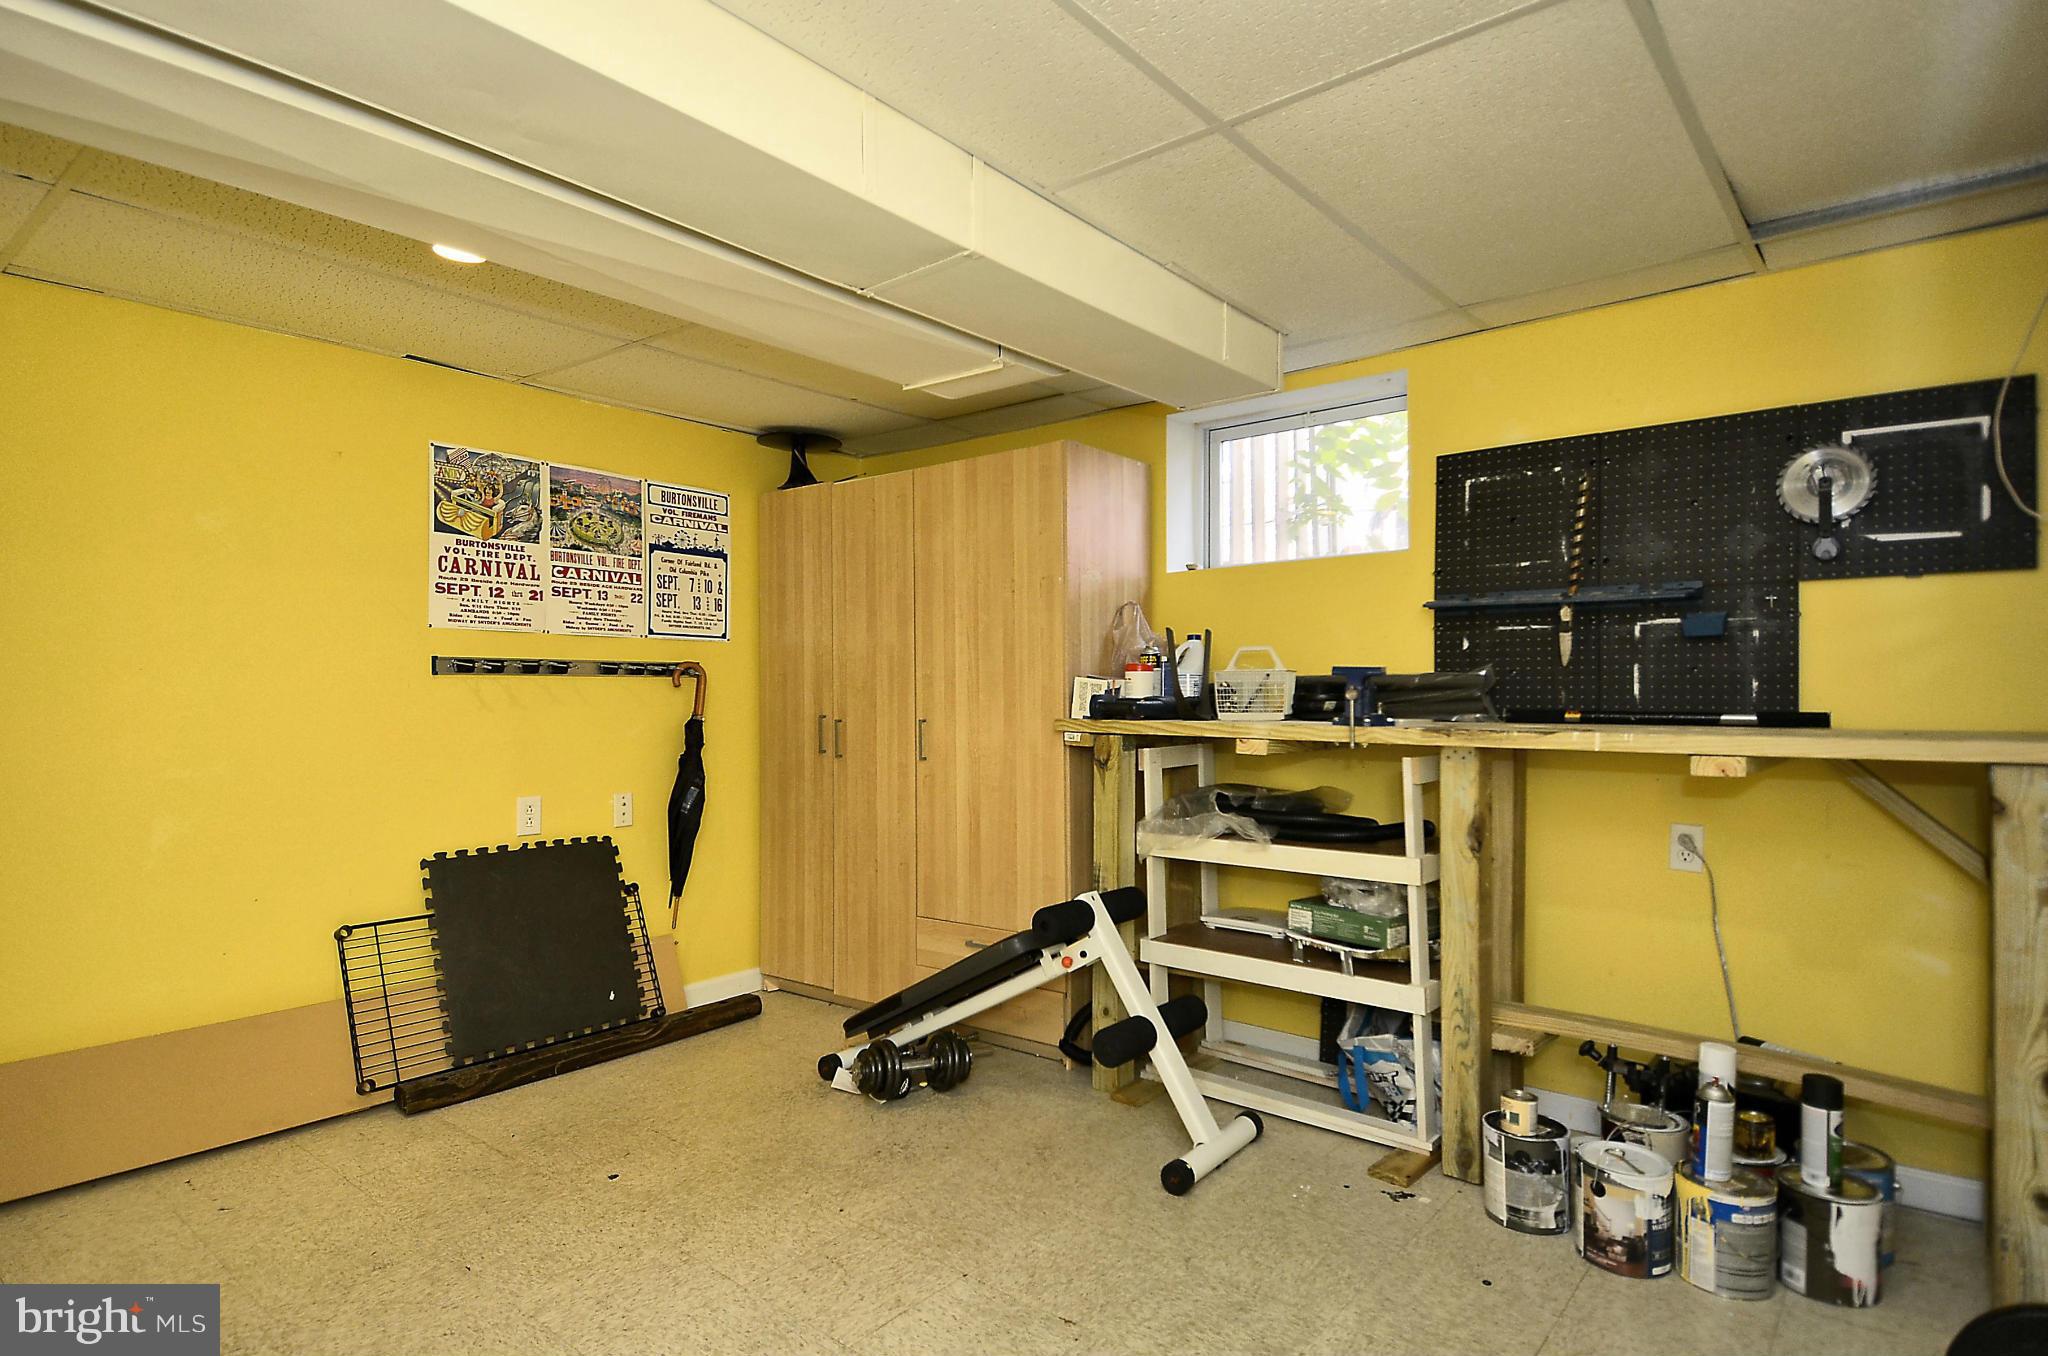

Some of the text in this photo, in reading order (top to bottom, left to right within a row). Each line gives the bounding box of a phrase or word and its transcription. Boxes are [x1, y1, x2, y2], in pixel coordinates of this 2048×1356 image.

[661, 491, 718, 511] BURTONSVILLE
[652, 515, 727, 532] CARNIVAL
[682, 511, 716, 521] FIREMANS
[444, 546, 536, 562] VOL. FIRE DEPT.
[456, 539, 525, 552] BURTONSVILLE
[438, 555, 540, 581] CARNIVAL
[551, 551, 642, 571] BURTONSVILLE VOL. FIRE DEPT.
[553, 567, 640, 584] CARNIVAL
[657, 574, 680, 591] SEPT.
[689, 578, 694, 592] 7
[704, 580, 712, 593] 10
[718, 582, 723, 595] &
[435, 582, 481, 596] SEPT.
[489, 587, 504, 598] 12
[529, 590, 543, 601] 21
[552, 586, 592, 599] SEPT.
[597, 590, 608, 600] 13
[631, 593, 642, 603] 22
[656, 593, 680, 609] SEPT.
[693, 596, 701, 610] 13
[714, 598, 722, 612] 16
